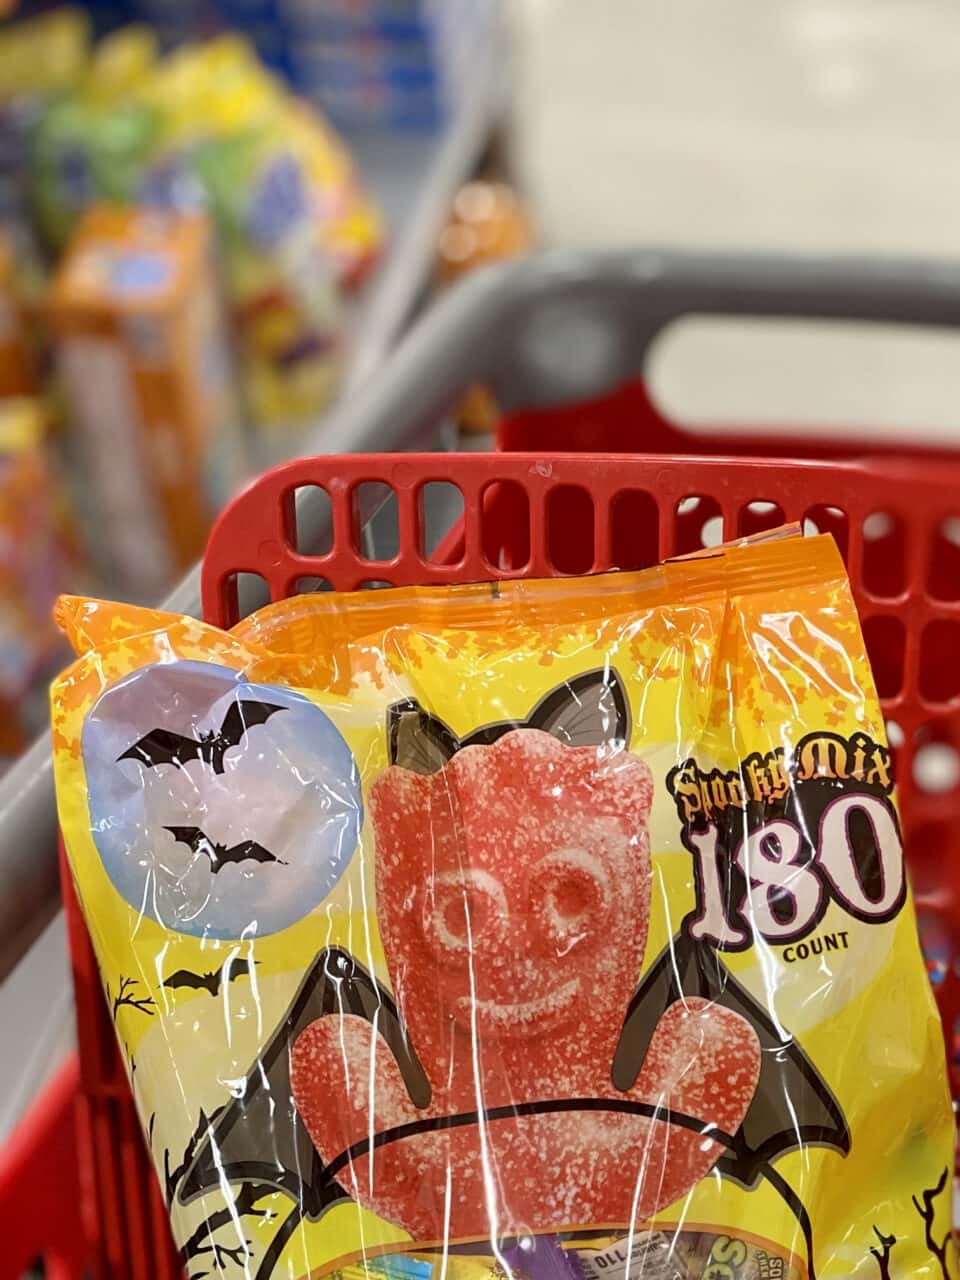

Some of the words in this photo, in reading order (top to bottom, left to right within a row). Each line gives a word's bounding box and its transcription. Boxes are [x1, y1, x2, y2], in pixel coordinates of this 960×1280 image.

[798, 736, 892, 788] Mix
[689, 793, 905, 945] 180
[783, 931, 850, 964] COUNT
